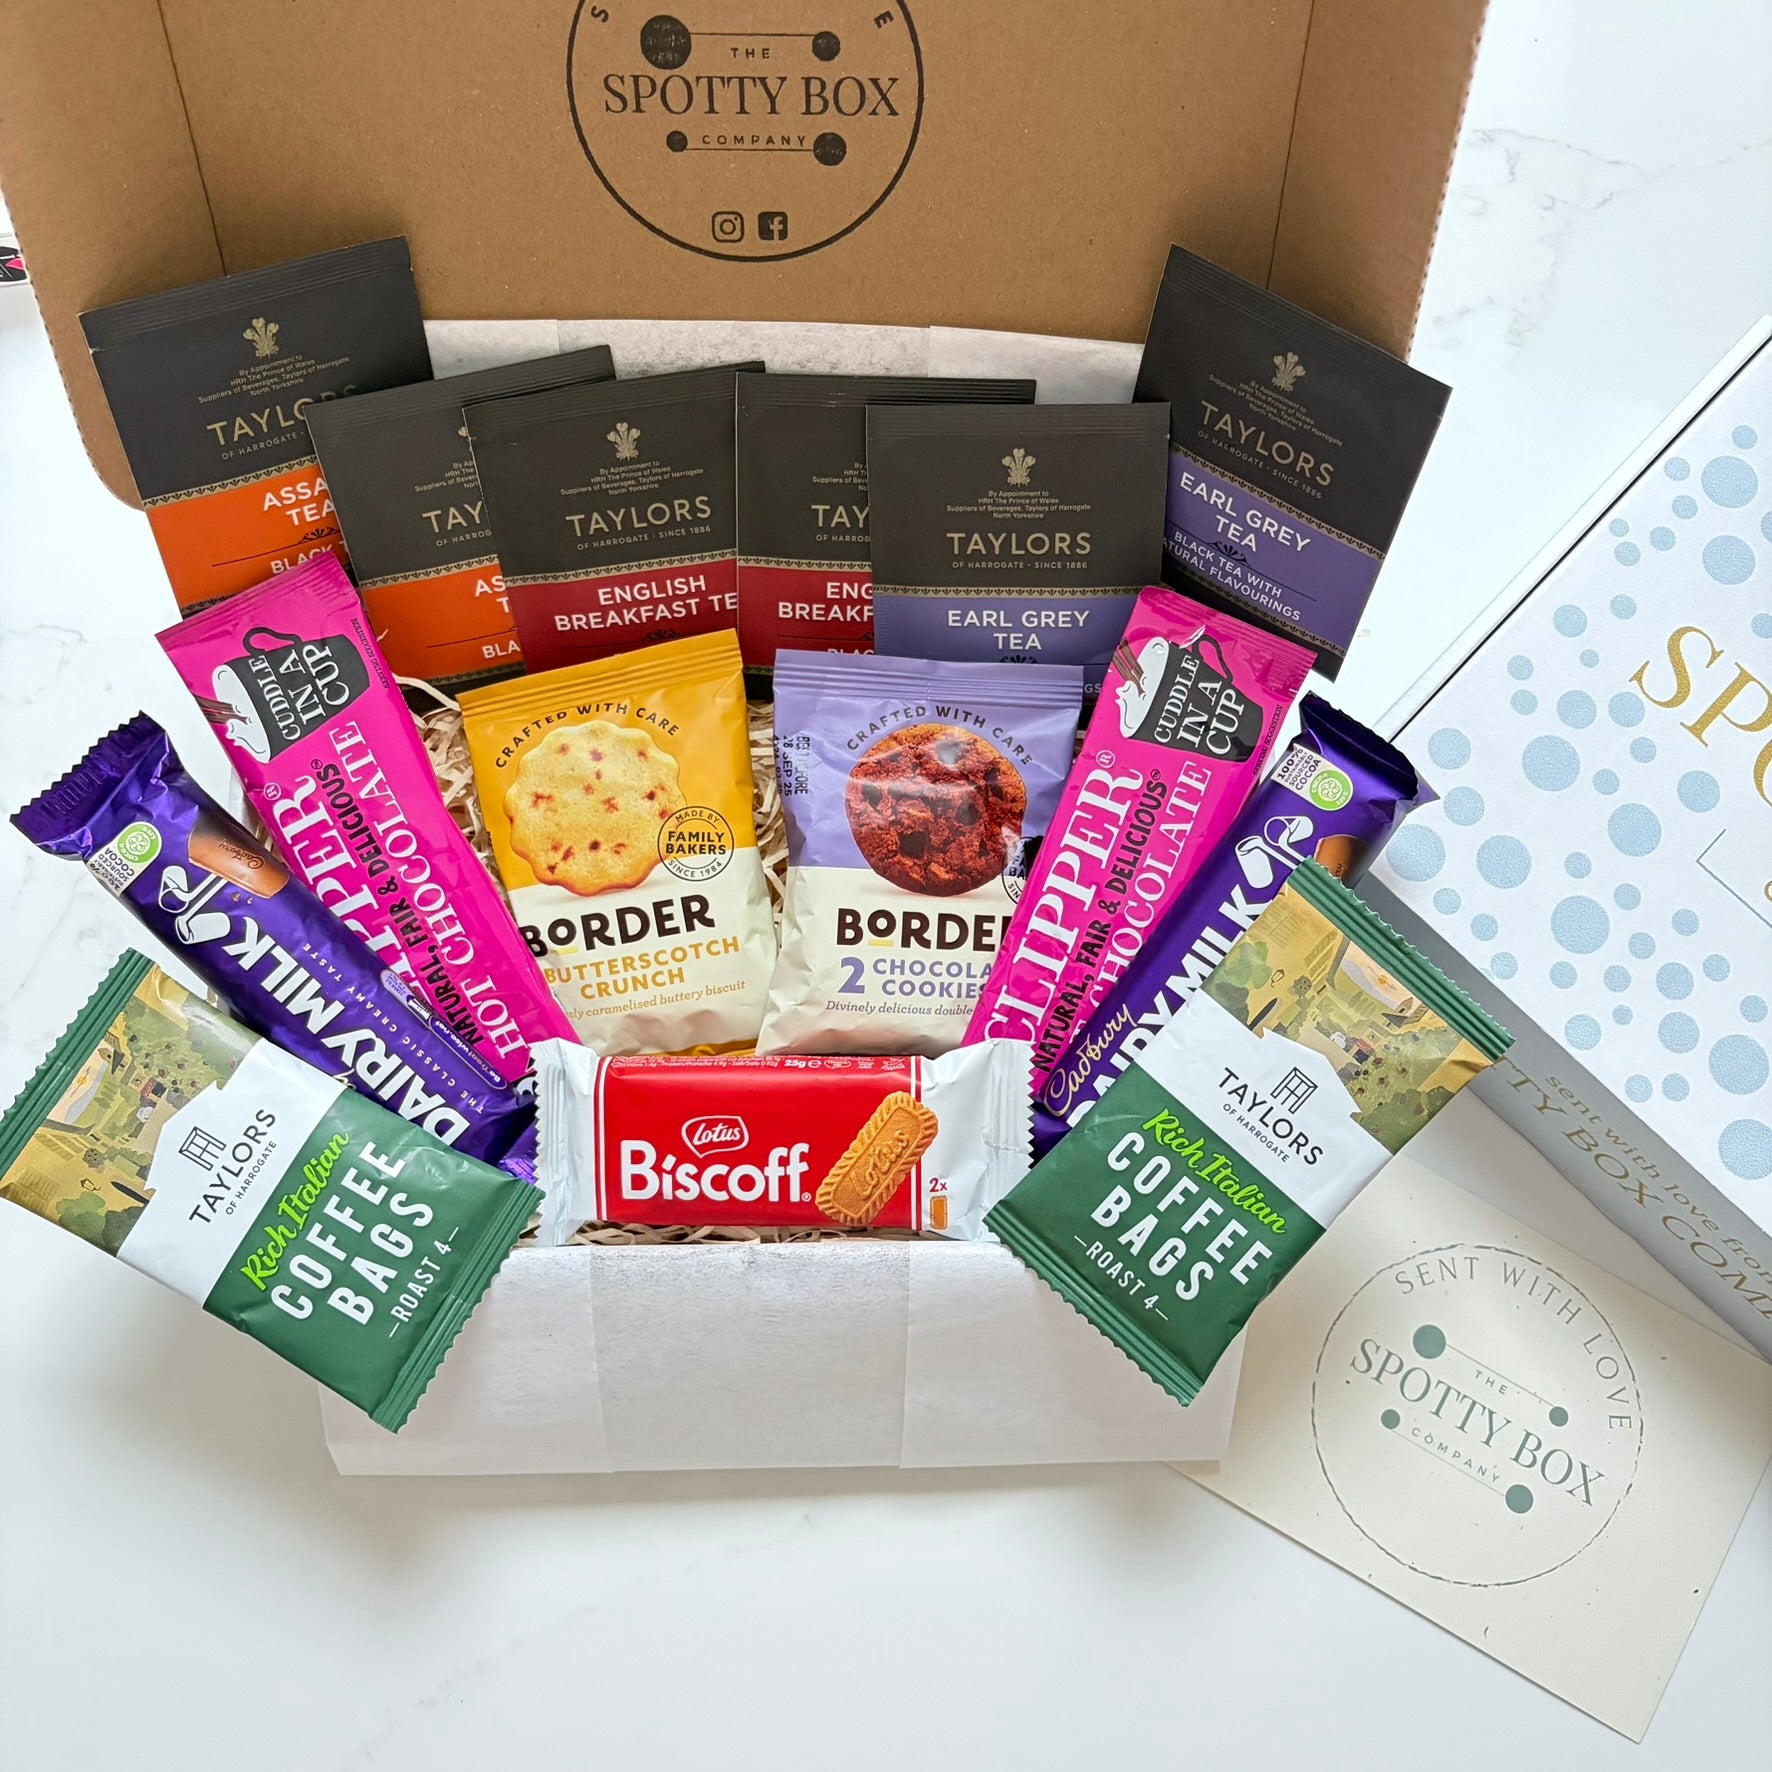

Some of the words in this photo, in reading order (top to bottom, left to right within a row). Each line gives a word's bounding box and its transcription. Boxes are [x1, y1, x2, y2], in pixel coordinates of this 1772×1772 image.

[731, 48, 771, 59] THE
[603, 73, 787, 116] SPOTTY
[800, 76, 900, 117] BOX
[702, 134, 806, 147] COMPANY
[221, 451, 235, 461] OF
[239, 431, 298, 455] HARROGATE
[1198, 430, 1209, 440] OF
[1212, 438, 1264, 469] HARROGATE
[1273, 468, 1298, 487] SINCE
[1301, 484, 1322, 499] 1886
[1201, 400, 1335, 486] TAYLORS
[263, 477, 327, 511] ASSA
[285, 499, 335, 526] TEA
[566, 496, 711, 537] TAYLORS
[947, 505, 978, 513] Suppliers
[1025, 505, 1048, 513] Taylors
[1050, 504, 1057, 512] of
[1058, 504, 1091, 513] Harrogate
[998, 490, 1041, 499] Appointment
[1179, 471, 1237, 517] EARL
[1245, 509, 1311, 552] GREY
[436, 539, 448, 547] OF
[452, 529, 492, 543] HARROG
[593, 534, 649, 548] HARROGATE
[659, 529, 686, 539] SINCE
[690, 525, 711, 535] 1886
[831, 535, 871, 543] HARROG
[946, 532, 1091, 555] TAYLORS
[1215, 514, 1257, 552] TEA
[952, 561, 965, 569] OF
[968, 561, 1024, 569] HARROGATE
[1034, 561, 1062, 569] SINCE
[1066, 561, 1088, 569] 1886
[1163, 537, 1206, 571] ATURAL
[1209, 567, 1301, 621] FLAVOURINGS
[1174, 531, 1215, 562] BLACK
[1219, 556, 1242, 578] TEA
[1247, 572, 1282, 598] WITH
[554, 598, 700, 631] BREAKFAST
[708, 592, 738, 612] TE
[598, 575, 706, 606] ENGLISH
[778, 601, 874, 622] BREAKF
[948, 610, 1013, 627] EARL
[1021, 610, 1090, 628] GREY
[993, 633, 1042, 650] TEA
[279, 649, 306, 676] A
[482, 640, 520, 659] BLA
[248, 655, 301, 741] CUDDLE
[302, 644, 350, 706] CUP
[287, 683, 326, 725] IN
[1153, 654, 1200, 744] CUDDLE
[1177, 702, 1209, 748] IN
[1198, 681, 1223, 706] A
[1206, 688, 1245, 755] CUP
[496, 711, 567, 768] CRAFTED
[576, 703, 628, 715] WITH
[636, 708, 679, 736] CARE
[847, 706, 927, 751] CRAFTED
[935, 706, 986, 728] WITH
[992, 727, 1033, 765] CARE
[784, 782, 792, 797] 25
[1289, 754, 1314, 786] SOURCED
[1295, 759, 1321, 790] COCOA
[316, 763, 390, 879] DELICIOUS
[668, 831, 725, 843] FAMILY
[675, 810, 704, 823] MADE
[707, 812, 720, 824] BY
[1105, 779, 1168, 895] DELICIOUS
[105, 848, 135, 876] COCOA
[328, 720, 475, 966] CHOCOLATE
[665, 843, 726, 855] BAKERS
[98, 853, 129, 882] SOURCED
[377, 875, 399, 896] &
[668, 859, 697, 878] SINCE
[700, 861, 723, 877] 1984
[389, 894, 429, 948] FAIR
[518, 894, 715, 957] BORDER
[984, 766, 1144, 1044] CLIPPER
[1098, 899, 1122, 916] &
[545, 936, 740, 983] BUTTERSCOTCH
[1075, 918, 1112, 968] FAIR
[1165, 884, 1273, 993] MILK
[222, 917, 345, 1034] MILK
[302, 943, 341, 982] TASTE
[581, 968, 685, 1000] CRUNCH
[837, 956, 865, 995] 2
[872, 958, 992, 979] CHOCOLA
[347, 985, 397, 1032] CREAMY
[459, 975, 528, 1060] HOT
[586, 998, 657, 1017] caramelised
[660, 989, 703, 1006] buttery
[705, 980, 746, 996] biscuit
[825, 1001, 876, 1015] Divinely
[879, 1002, 932, 1015] delicious
[934, 1004, 973, 1016] double
[402, 1036, 456, 1087] CLASSIC
[784, 1059, 807, 1069] 25g
[1043, 1003, 1137, 1117] Cadbury
[321, 1029, 470, 1145] DAIRY
[461, 1091, 484, 1113] THE
[693, 1123, 741, 1146] Lotus
[1217, 1067, 1325, 1166] TAYLORS
[1223, 1103, 1236, 1116] OF
[1237, 1115, 1290, 1163] HARROGATE
[189, 1109, 276, 1224] TAYLORS
[620, 1140, 811, 1203] Biscoff
[1142, 1108, 1205, 1169] Rich
[1195, 1153, 1287, 1235] Italian
[1546, 1076, 1604, 1124] sent
[1605, 1127, 1661, 1181] with
[1663, 1183, 1720, 1232] love
[226, 1201, 237, 1216] OF
[236, 1140, 277, 1199] HARROGATE
[929, 1178, 948, 1192] 2x
[241, 1222, 298, 1292] Rich
[278, 1131, 349, 1231] Italian
[270, 1141, 406, 1320] COFFEE
[1107, 1132, 1272, 1285] COFFEE
[1562, 1126, 1664, 1208] BOX
[1662, 1215, 1772, 1320] COM
[327, 1192, 434, 1325] BAGS
[1090, 1185, 1214, 1300] BAGS
[391, 1256, 440, 1322] ROAST
[434, 1239, 451, 1255] 4
[1085, 1240, 1145, 1296] ROAST
[1144, 1295, 1160, 1309] 4
[1394, 1256, 1479, 1295] SENT
[1502, 1262, 1582, 1325] WITH
[1583, 1333, 1632, 1429] LOVE
[1474, 1369, 1507, 1395] THE
[1350, 1338, 1512, 1448] SPOTTY
[1510, 1428, 1605, 1507] BOX
[1411, 1427, 1500, 1483] COMPANY
